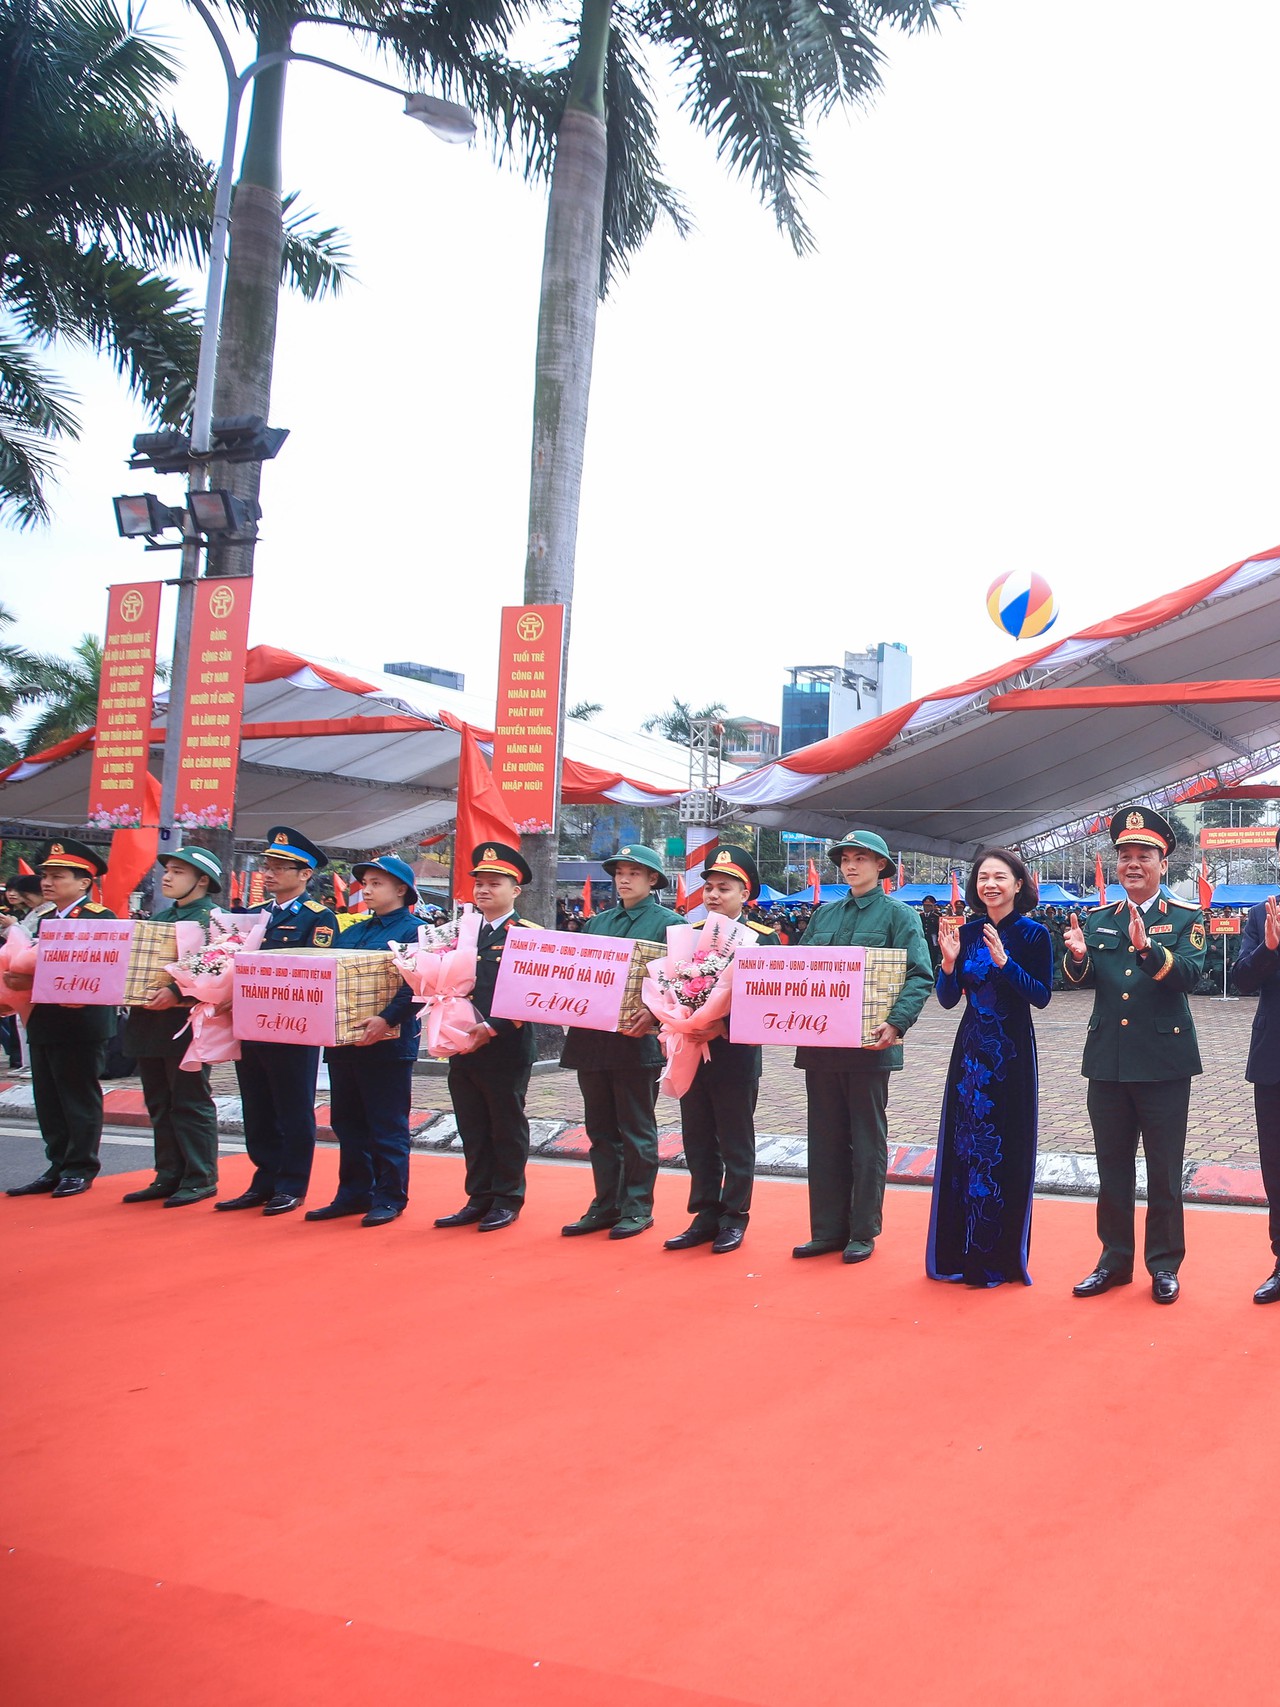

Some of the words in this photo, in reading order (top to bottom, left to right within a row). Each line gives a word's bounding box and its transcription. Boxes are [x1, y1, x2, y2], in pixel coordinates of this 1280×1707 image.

[513, 650, 529, 662] TUỔI
[531, 650, 544, 662] TRẺ
[512, 670, 532, 680] CÔNG
[534, 672, 544, 680] AN
[508, 688, 529, 698] NHÂN
[530, 688, 546, 698] DÂN
[508, 706, 527, 717] PHÁT
[529, 708, 544, 716] HUY
[497, 724, 525, 735] TRUYỀN
[506, 743, 527, 753] HĂNG
[529, 743, 542, 753] HÁI
[503, 761, 517, 772] LÊN
[518, 761, 544, 772] ĐƯỜNG
[502, 780, 523, 792] NHẬP
[524, 780, 543, 790] NGŨ!
[44, 948, 70, 962] THÀNH
[71, 946, 90, 962] PHỐ
[90, 948, 101, 962] HÀ
[104, 948, 119, 965] NỘI
[738, 958, 756, 969] THÀNH
[757, 957, 765, 970] ỦY
[769, 960, 785, 970] HĐND
[790, 960, 805, 971] UBND
[810, 961, 832, 972] UBMTTQ
[834, 959, 846, 973] VIỆT
[847, 962, 861, 972] NAM
[513, 960, 550, 977] THÀNH
[551, 962, 577, 980] PHỐ
[577, 967, 592, 982] HÀ
[594, 969, 615, 987] NỘI
[54, 974, 100, 994] TẶNG
[746, 978, 781, 996] THÀNH
[785, 978, 808, 997] PHỐ
[811, 980, 826, 997] HÀ
[830, 981, 850, 1001] NỘI
[241, 983, 270, 999] THÀNH
[272, 983, 291, 1001] PHỐ
[292, 986, 305, 1002] HÀ
[307, 987, 323, 1006] NỘI
[525, 992, 589, 1017] TẶNG
[256, 1013, 307, 1034] TẶNG
[763, 1010, 828, 1035] TẶNG
